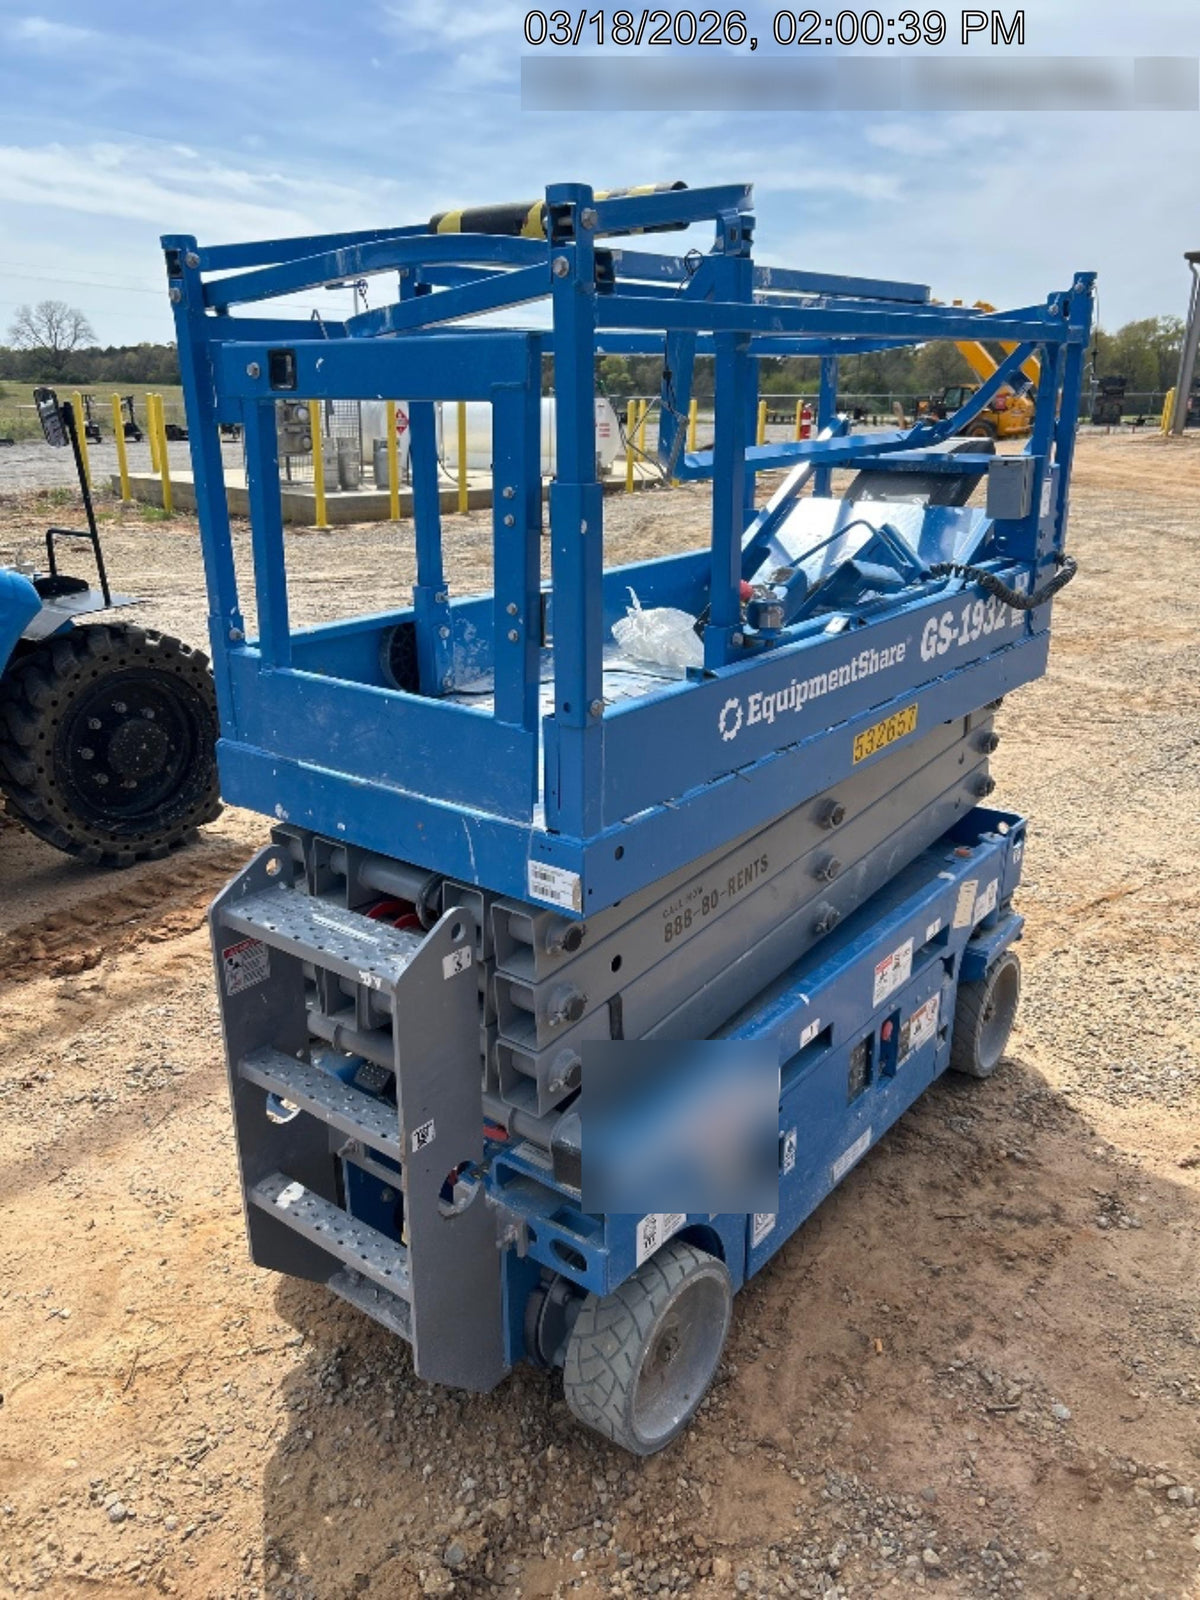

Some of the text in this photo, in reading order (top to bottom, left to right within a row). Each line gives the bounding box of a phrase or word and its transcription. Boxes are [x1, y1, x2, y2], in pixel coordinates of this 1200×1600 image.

[920, 594, 1007, 662] GS-1932
[746, 642, 906, 725] EquipmentShare
[854, 705, 917, 762] 532657
[664, 853, 769, 943] 888-80-RENTS
